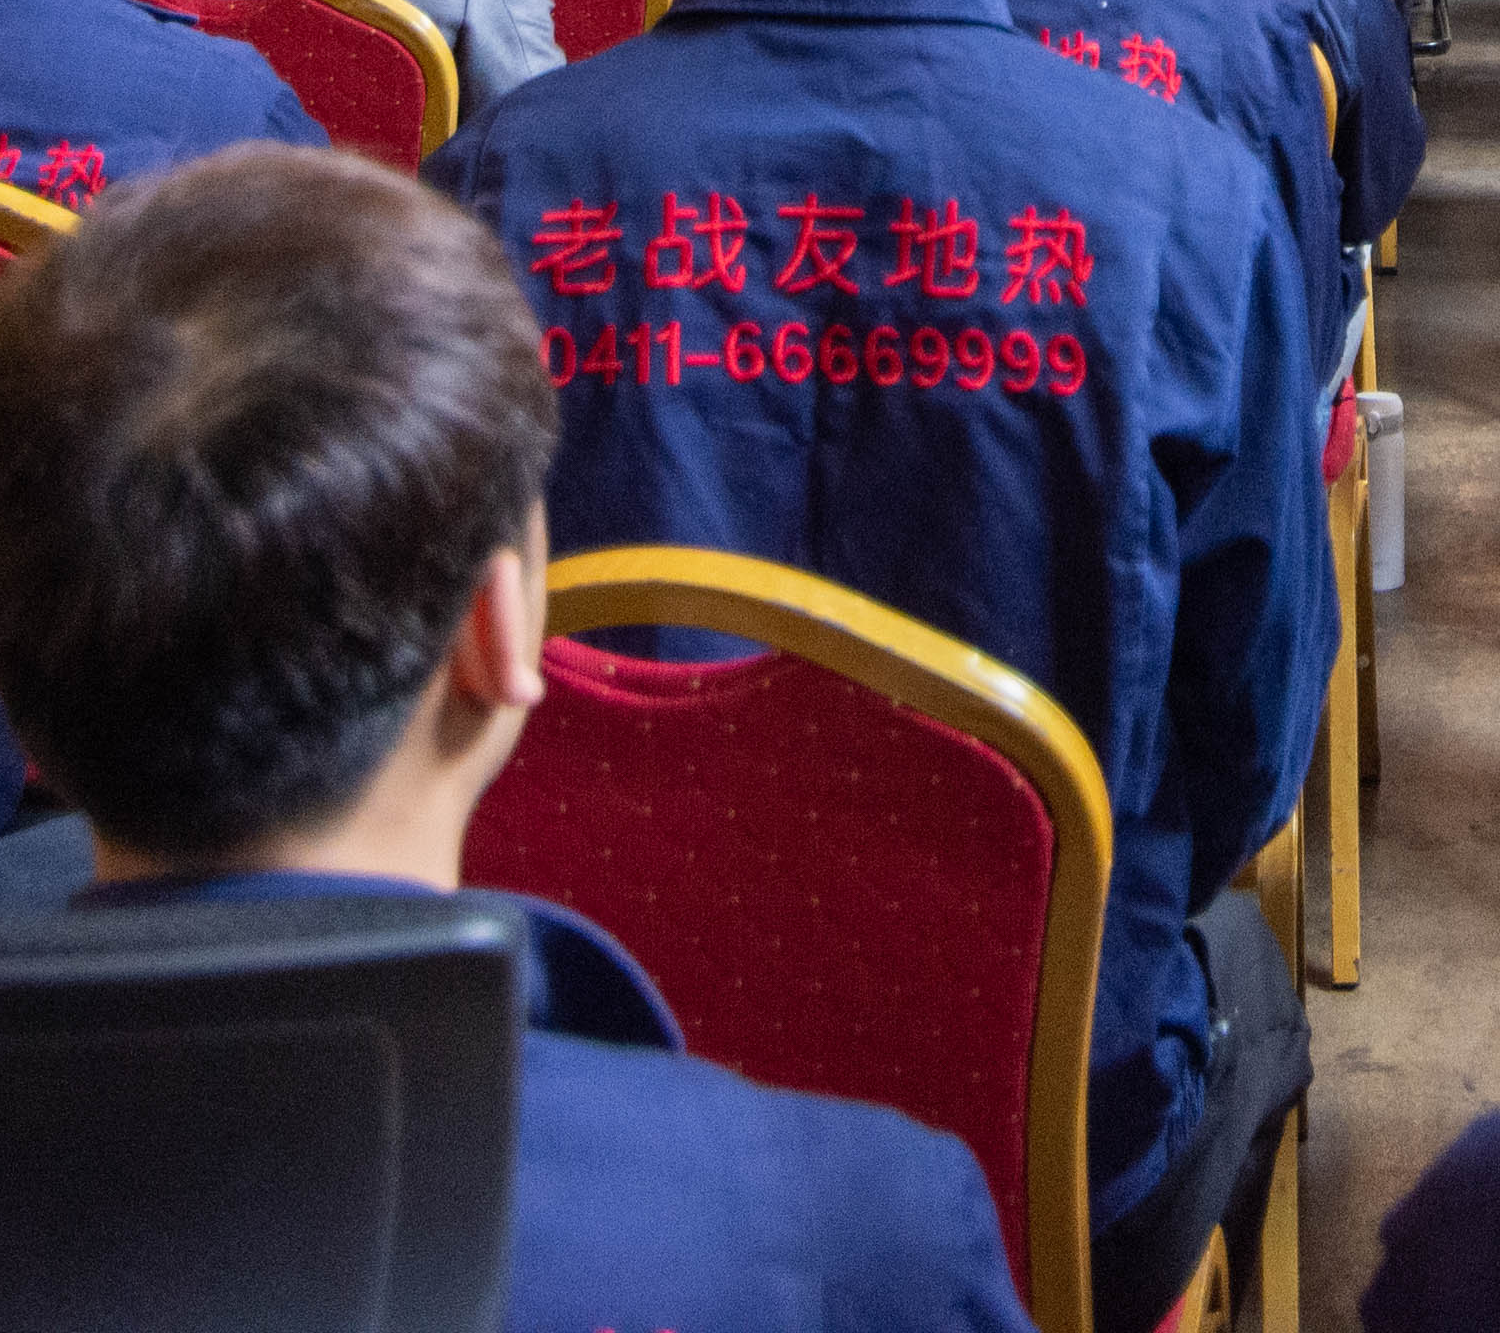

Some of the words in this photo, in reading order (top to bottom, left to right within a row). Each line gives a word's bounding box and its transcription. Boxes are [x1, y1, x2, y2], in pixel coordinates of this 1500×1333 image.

[530, 191, 1095, 308] 老战友地热
[541, 319, 1088, 397] 0411-66669999
